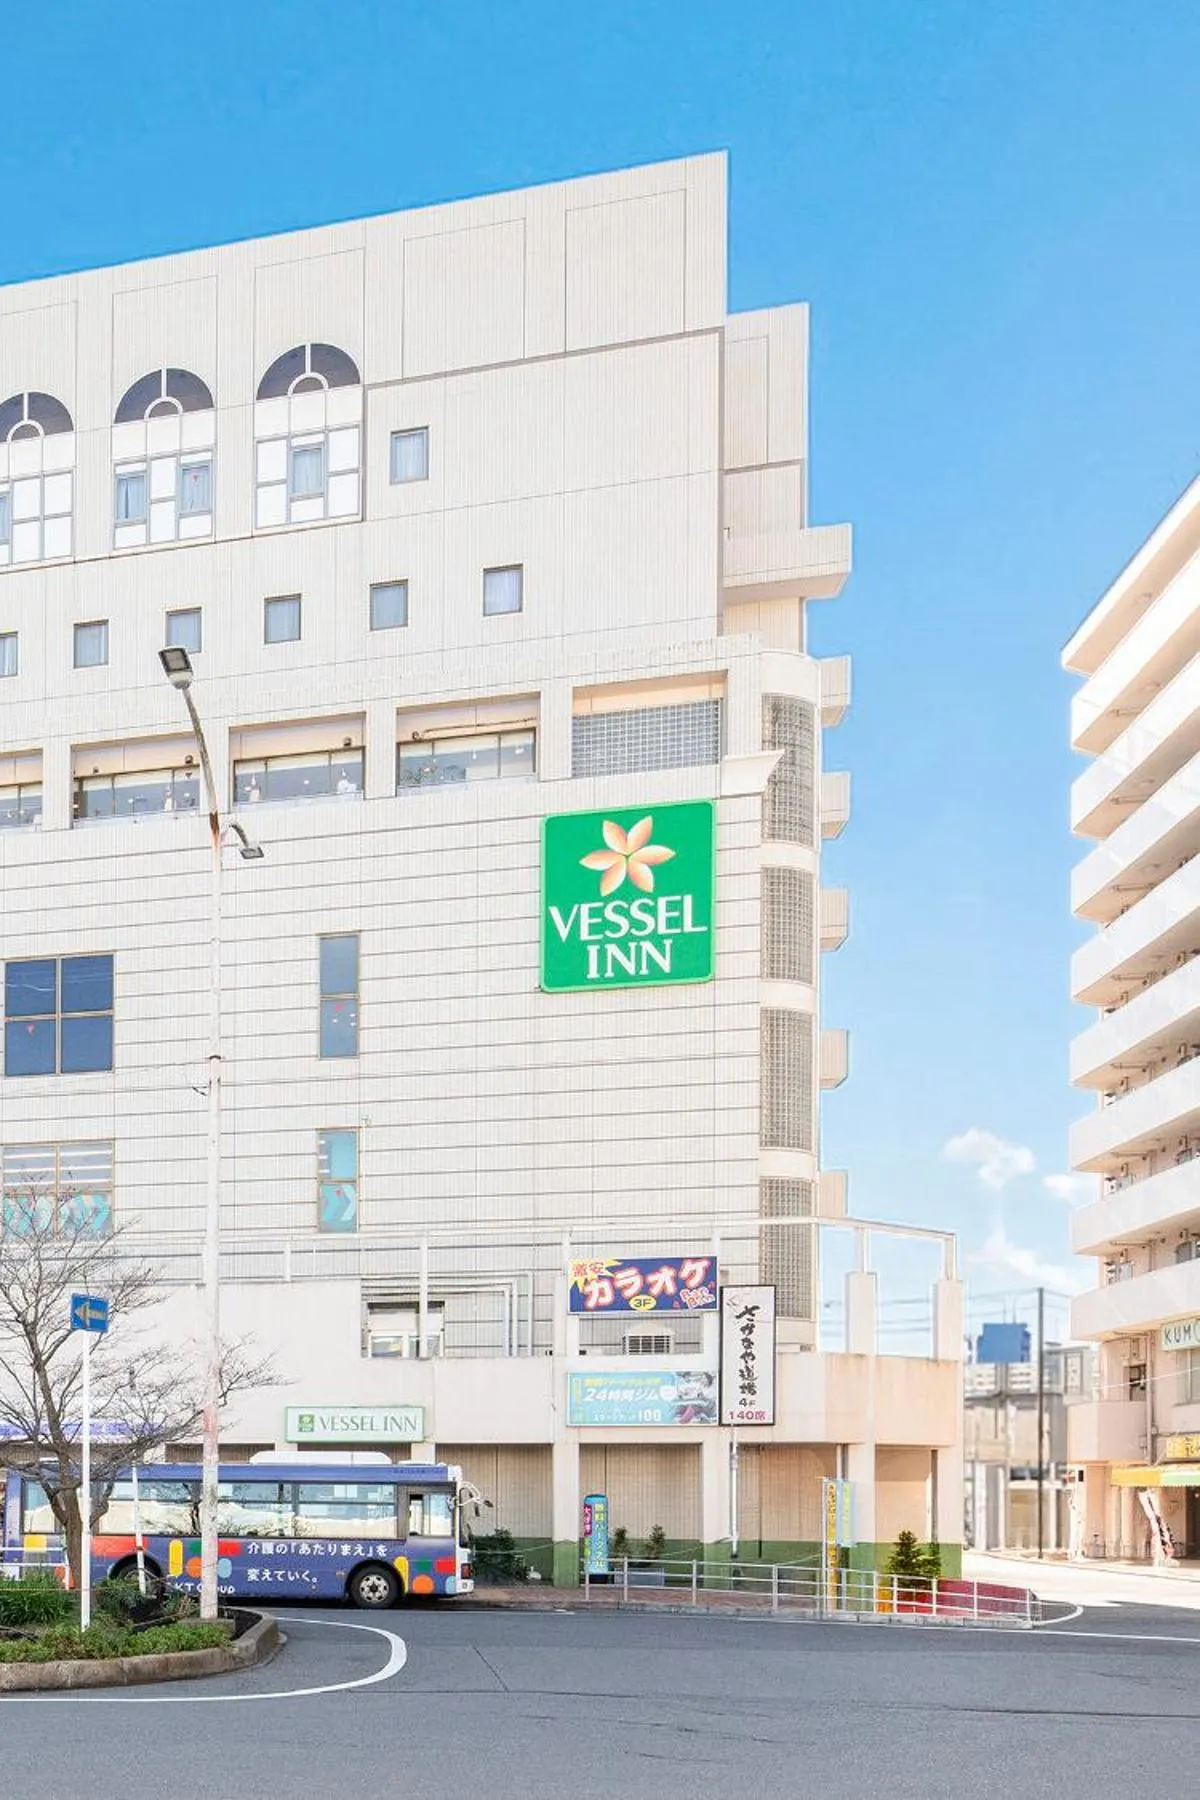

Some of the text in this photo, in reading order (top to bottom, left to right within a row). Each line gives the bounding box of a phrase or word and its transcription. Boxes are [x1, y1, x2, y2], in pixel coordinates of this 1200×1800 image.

[548, 893, 708, 942] VESSEL
[586, 939, 673, 980] INN
[584, 1259, 711, 1309] カラオケ
[633, 1297, 653, 1308] 3F
[735, 1305, 760, 1396] さかなや道場
[739, 1399, 756, 1408] 4F
[319, 1415, 417, 1432] VESSEL INN
[728, 1410, 766, 1421] 140席
[247, 1542, 388, 1557] 介護の「あたりまえ」を
[247, 1569, 318, 1583] 変えていく。
